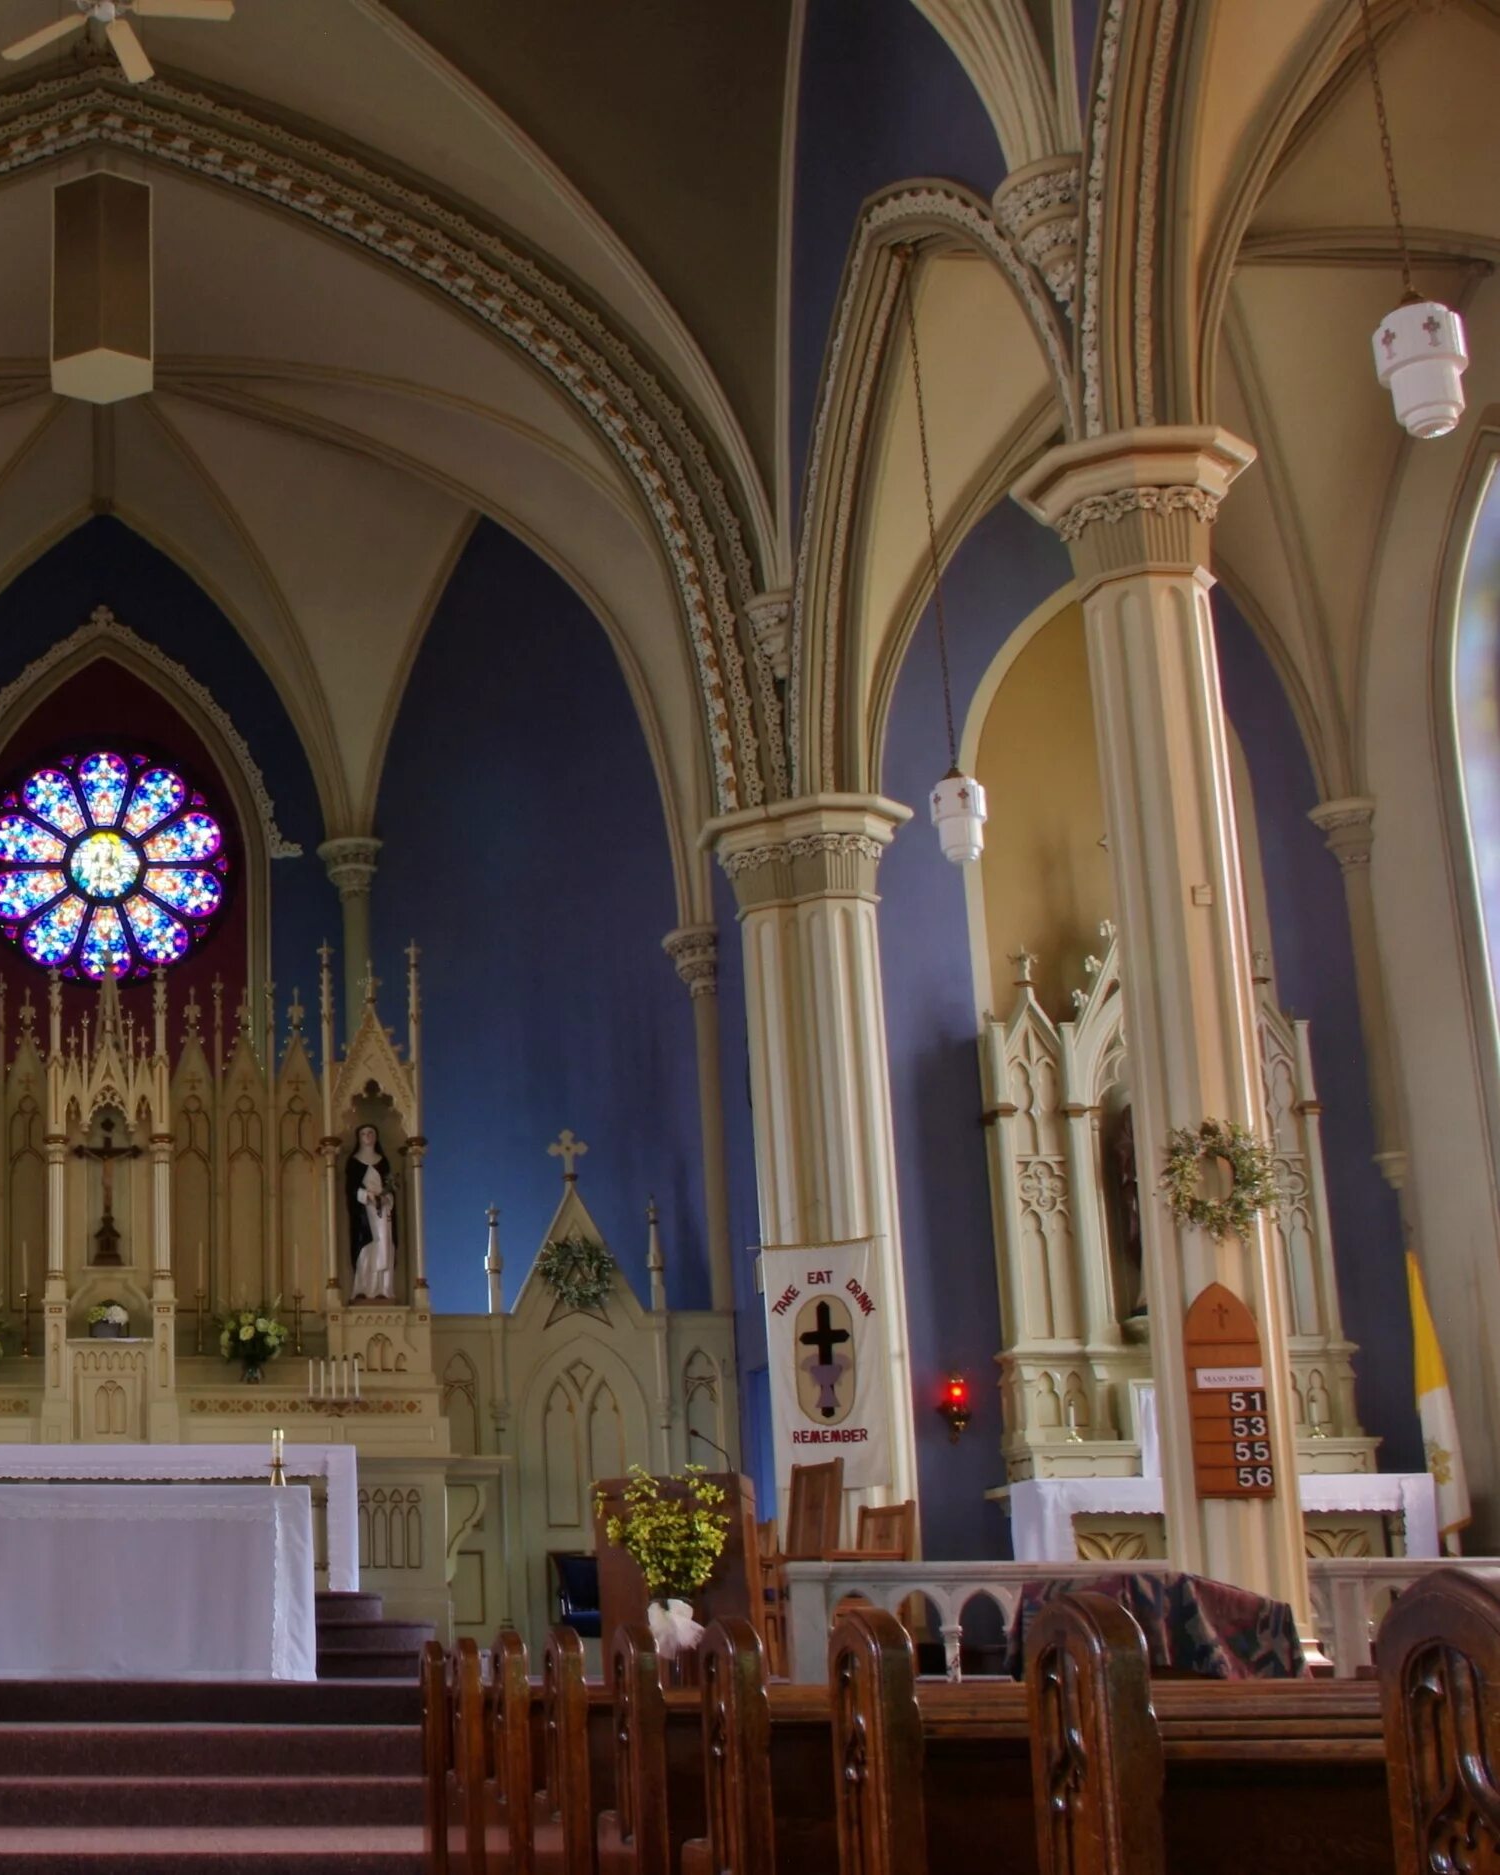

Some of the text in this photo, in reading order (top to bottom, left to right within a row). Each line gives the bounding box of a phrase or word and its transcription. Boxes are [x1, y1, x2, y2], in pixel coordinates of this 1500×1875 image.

[771, 1270, 876, 1317] TAKE EAT DRINK
[1203, 1374, 1256, 1383] MASS PARTS
[1230, 1392, 1263, 1412] 51
[793, 1428, 868, 1444] REMEMBER
[1233, 1417, 1267, 1438] 53
[1235, 1442, 1270, 1462] 55
[1238, 1466, 1273, 1488] 56
